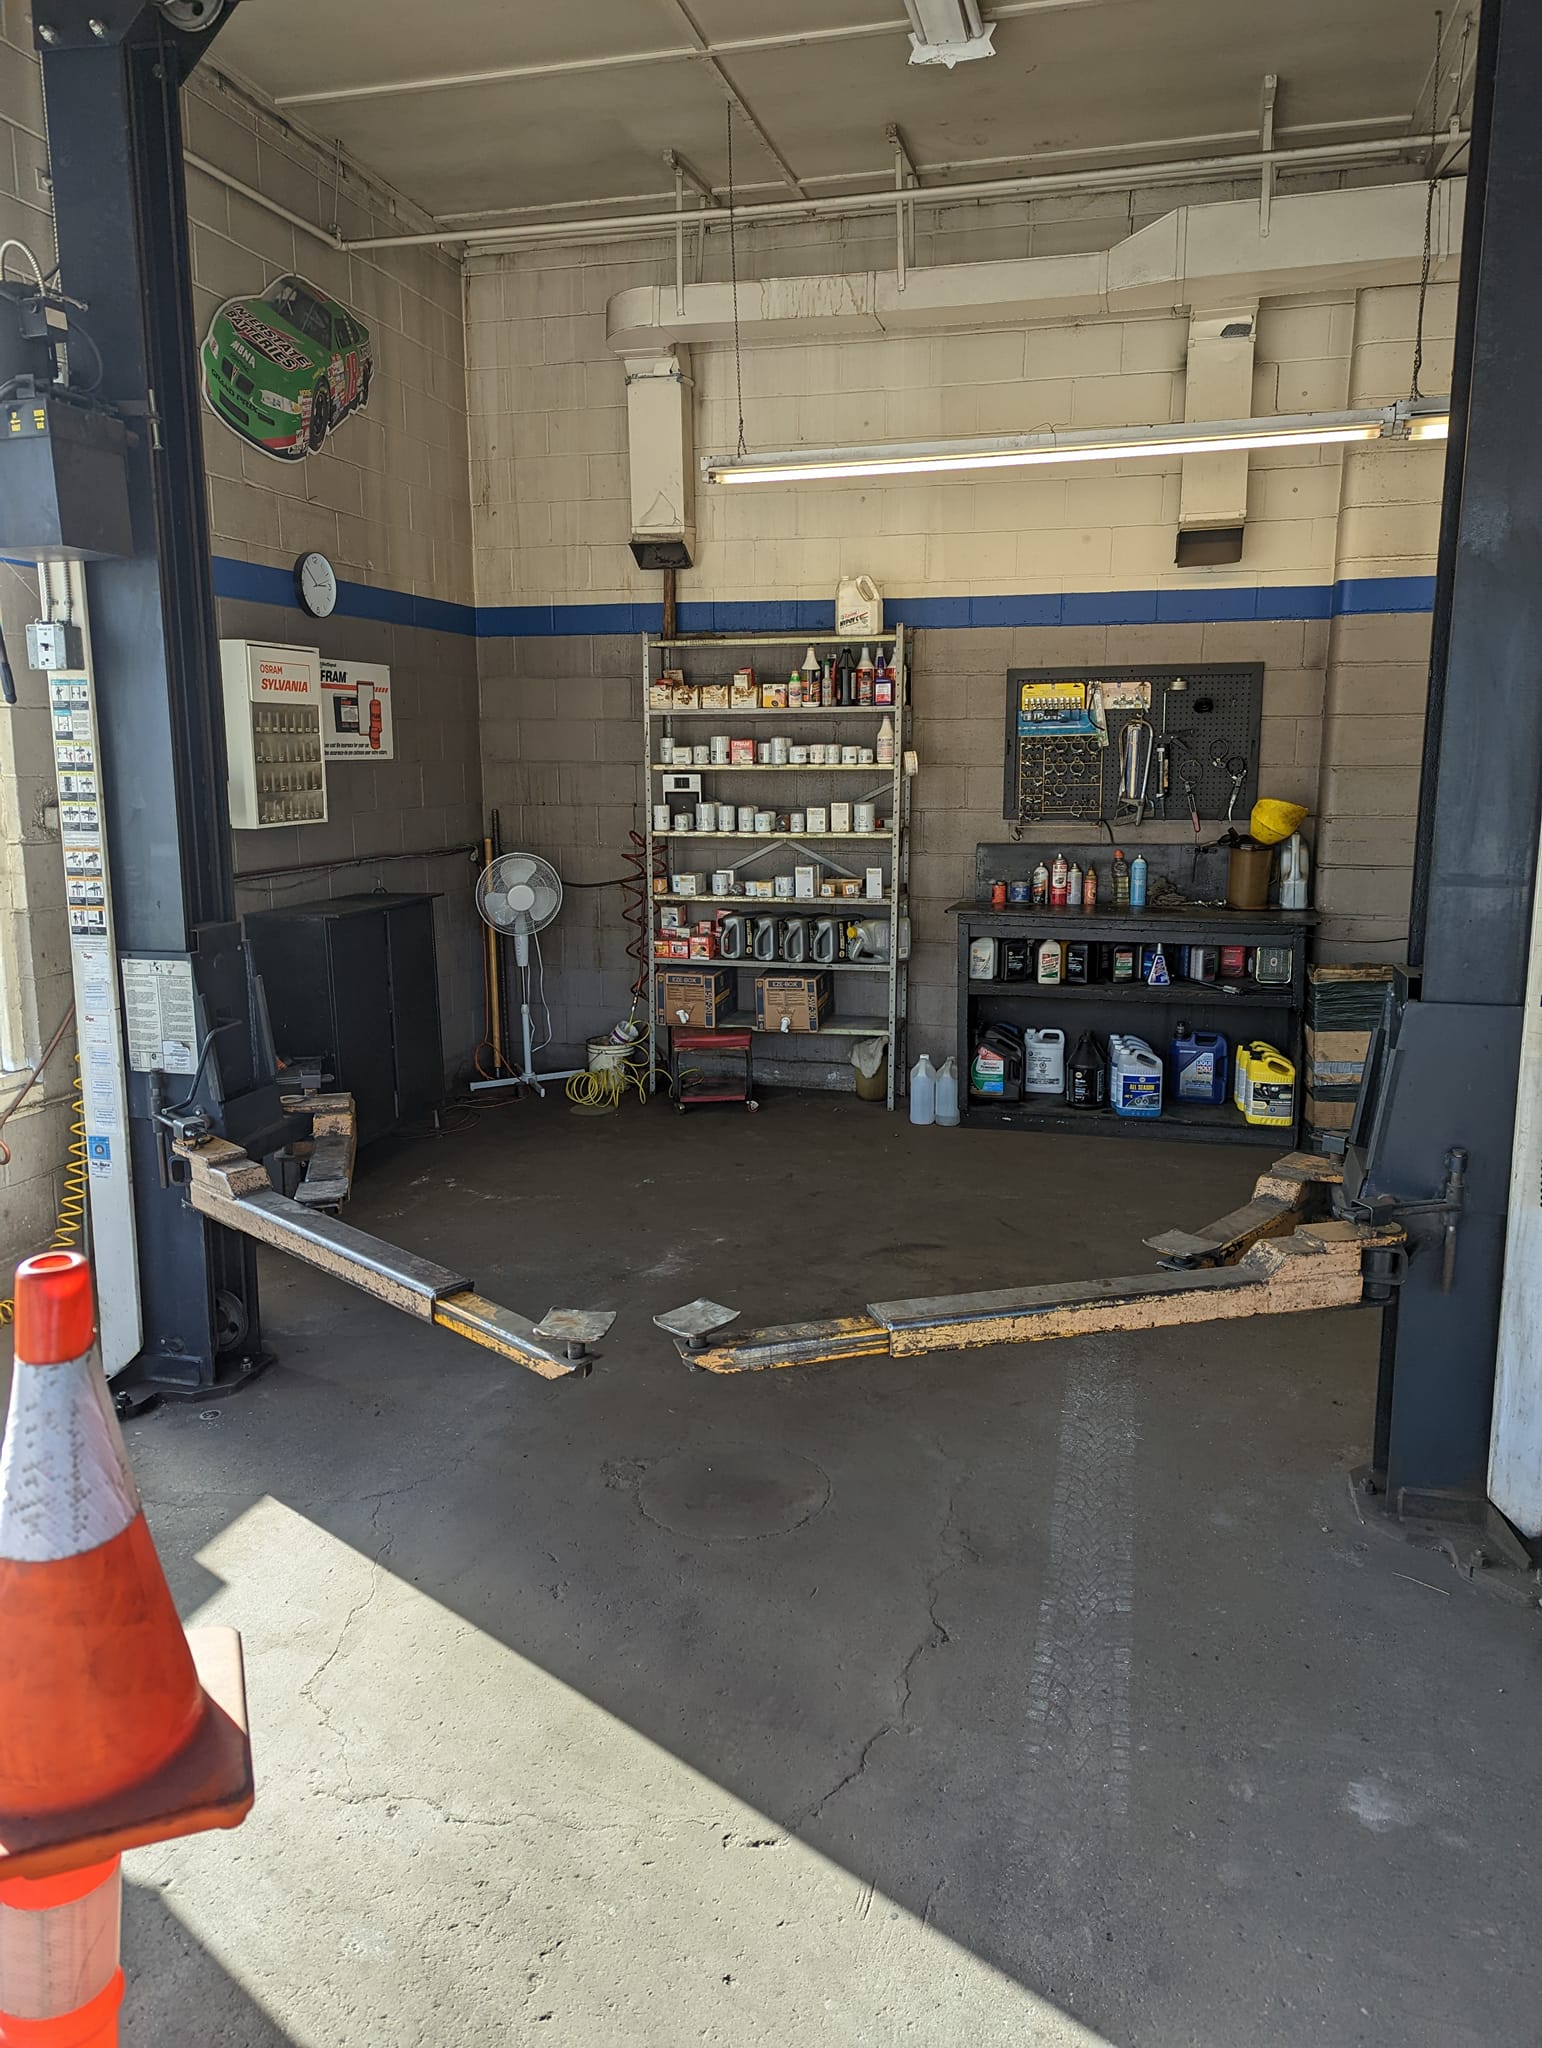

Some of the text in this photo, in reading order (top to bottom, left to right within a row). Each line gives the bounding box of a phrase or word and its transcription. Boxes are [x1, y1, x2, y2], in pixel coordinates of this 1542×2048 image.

[224, 309, 297, 371] BATTERIES
[231, 304, 314, 368] INTERSTATE
[230, 340, 256, 369] MBNA
[260, 663, 283, 675] OSRAM
[320, 669, 347, 684] FRAM
[261, 678, 308, 693] SYLVANIA
